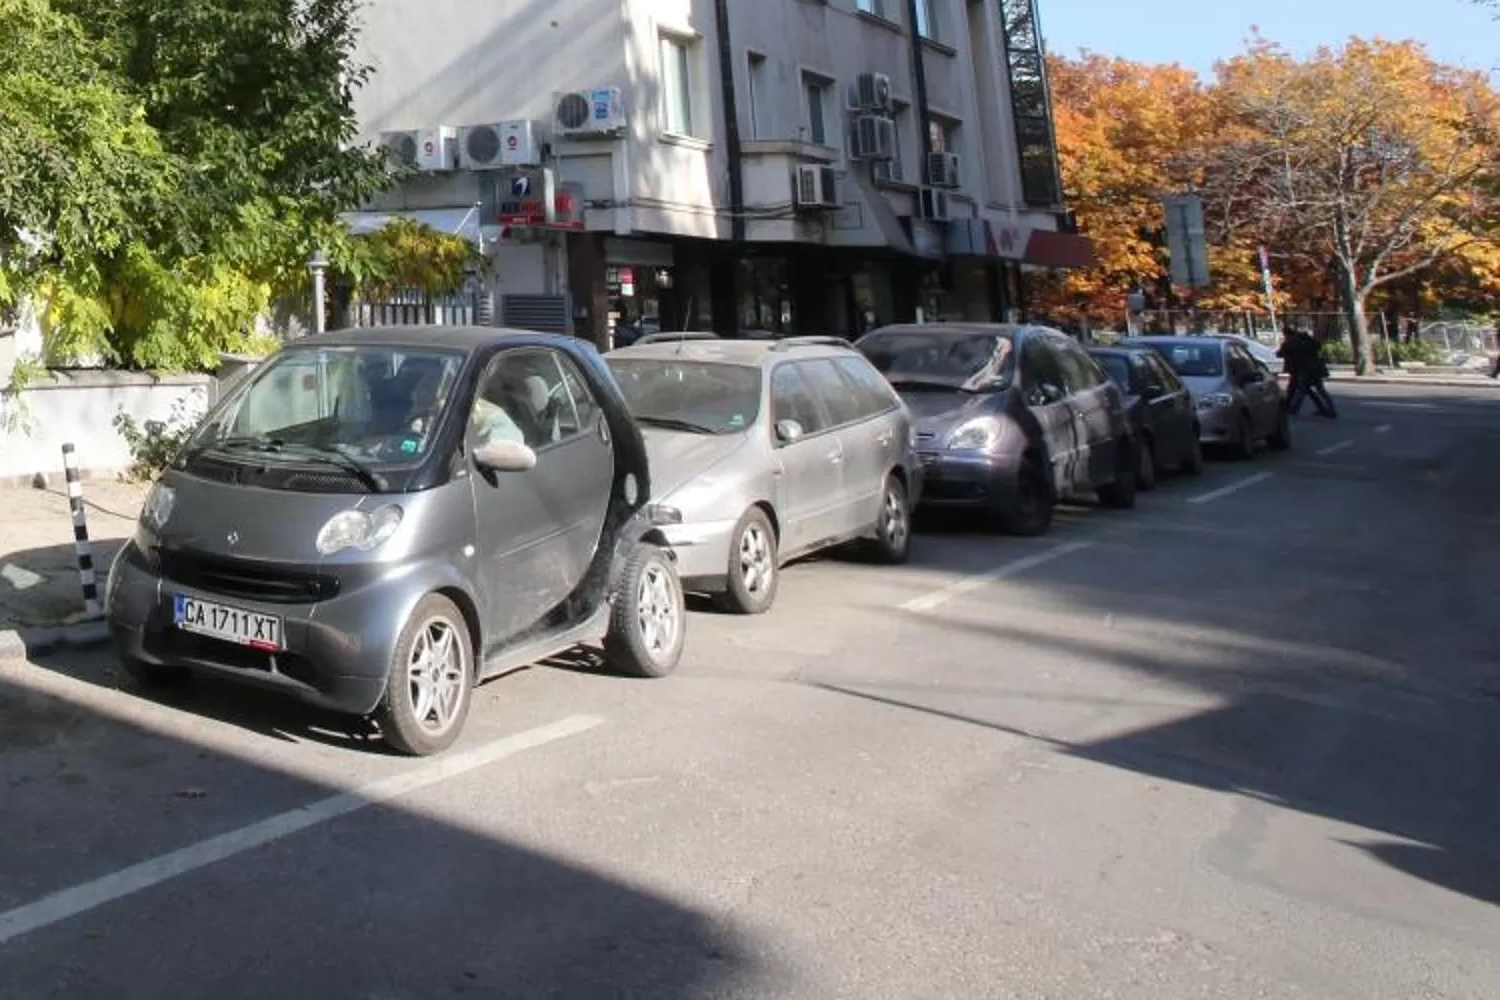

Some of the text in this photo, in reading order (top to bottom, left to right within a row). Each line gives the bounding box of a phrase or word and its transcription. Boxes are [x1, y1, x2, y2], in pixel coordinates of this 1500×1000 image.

[185, 601, 278, 642] CA 1711 XT
